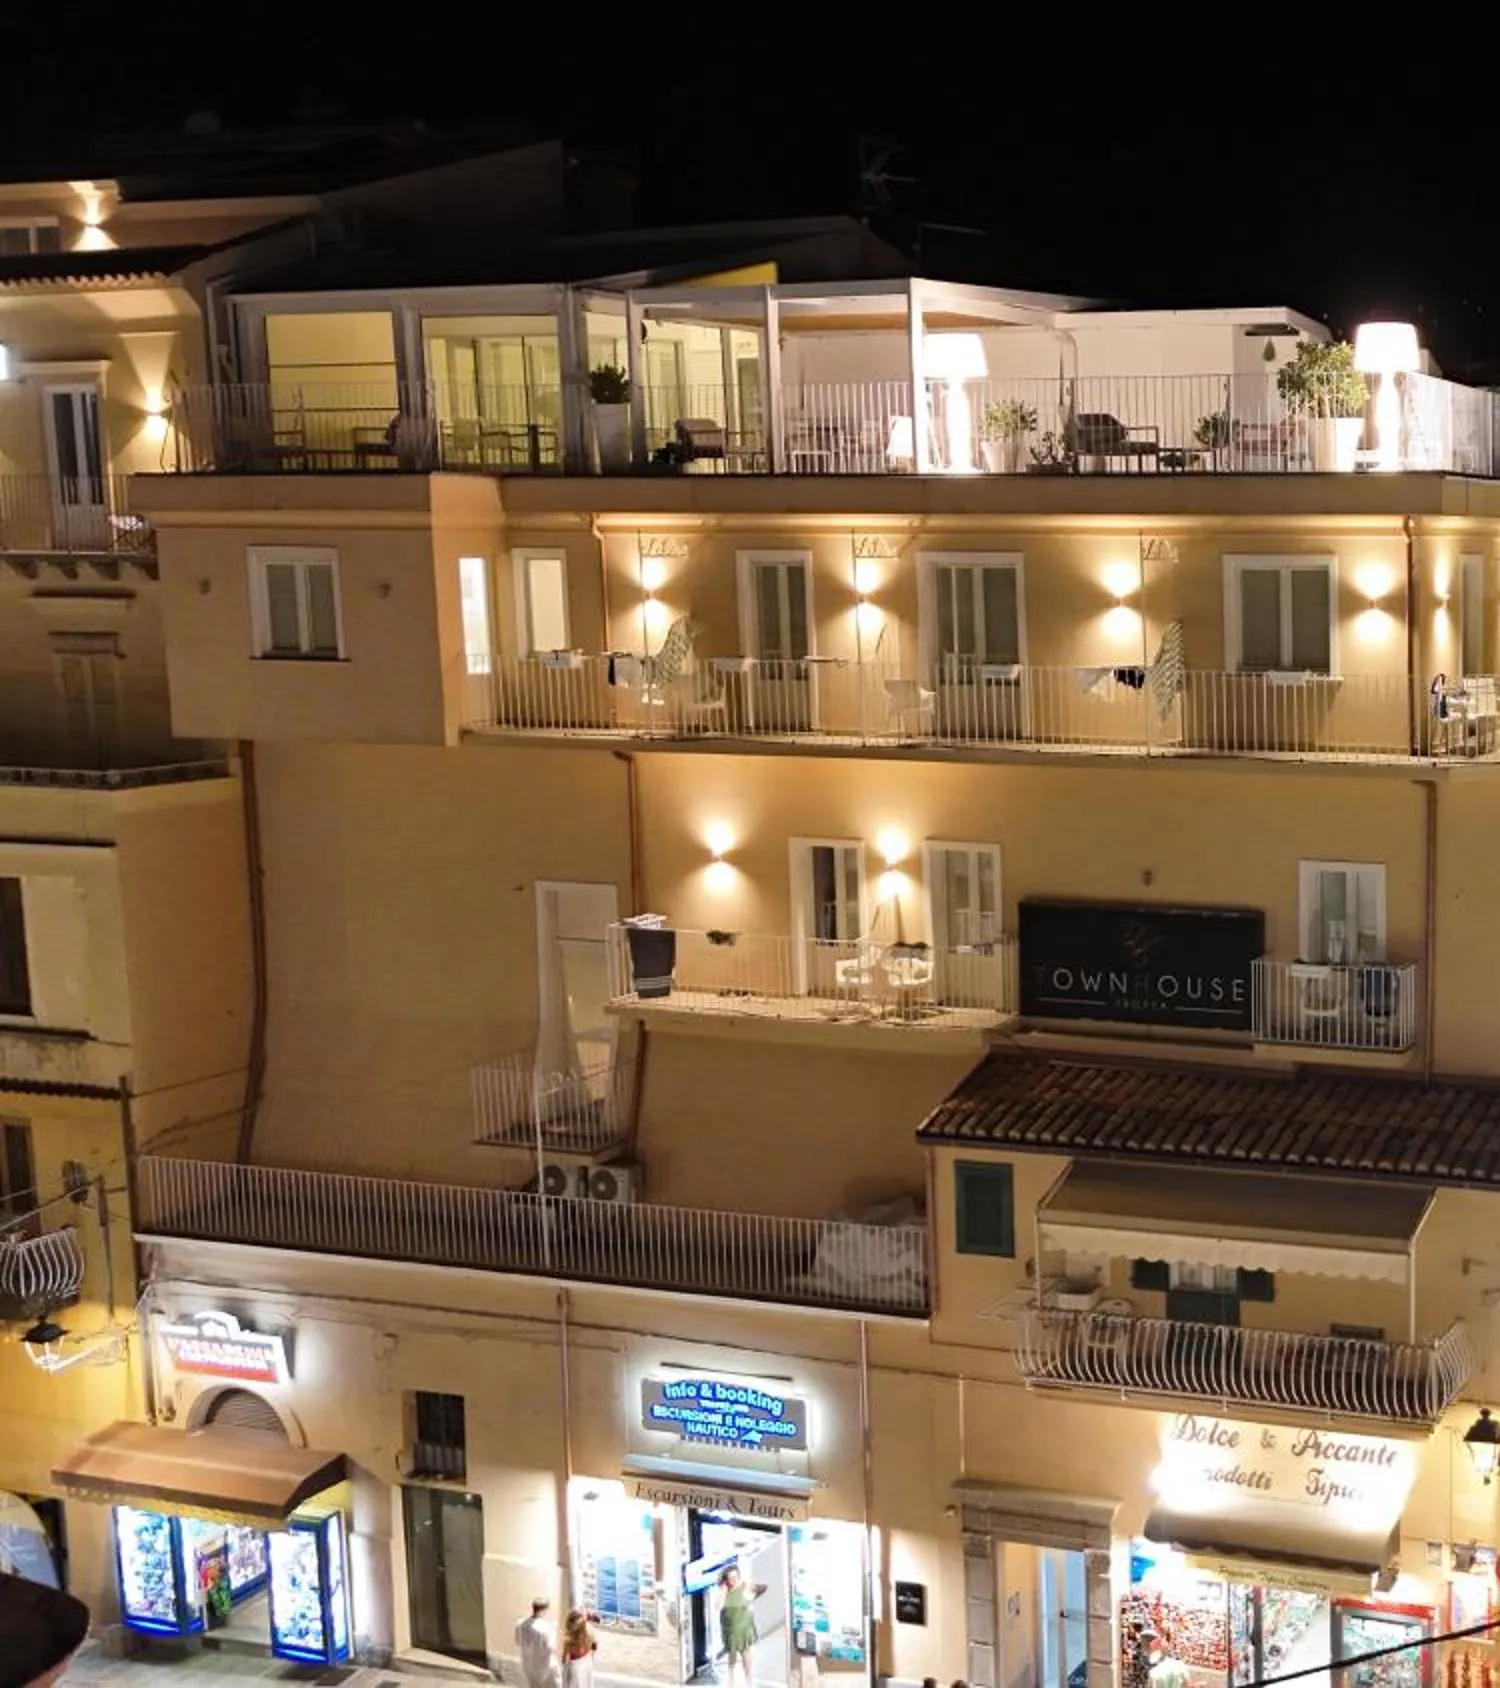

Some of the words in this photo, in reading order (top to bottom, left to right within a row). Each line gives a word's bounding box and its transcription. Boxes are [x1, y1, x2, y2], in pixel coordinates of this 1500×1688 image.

[715, 1383, 783, 1417] booking
[653, 1405, 723, 1425] ESCURSIONI
[735, 1416, 797, 1435] NOLEGGIO
[687, 1422, 739, 1438] NAUTICO
[1170, 1413, 1241, 1449] Dolce
[1260, 1428, 1278, 1450] &
[1291, 1429, 1399, 1467] Piccante
[1201, 1464, 1274, 1491] rodotti
[635, 1481, 720, 1510] Escursioni
[725, 1497, 740, 1511] &
[749, 1497, 795, 1519] Tours
